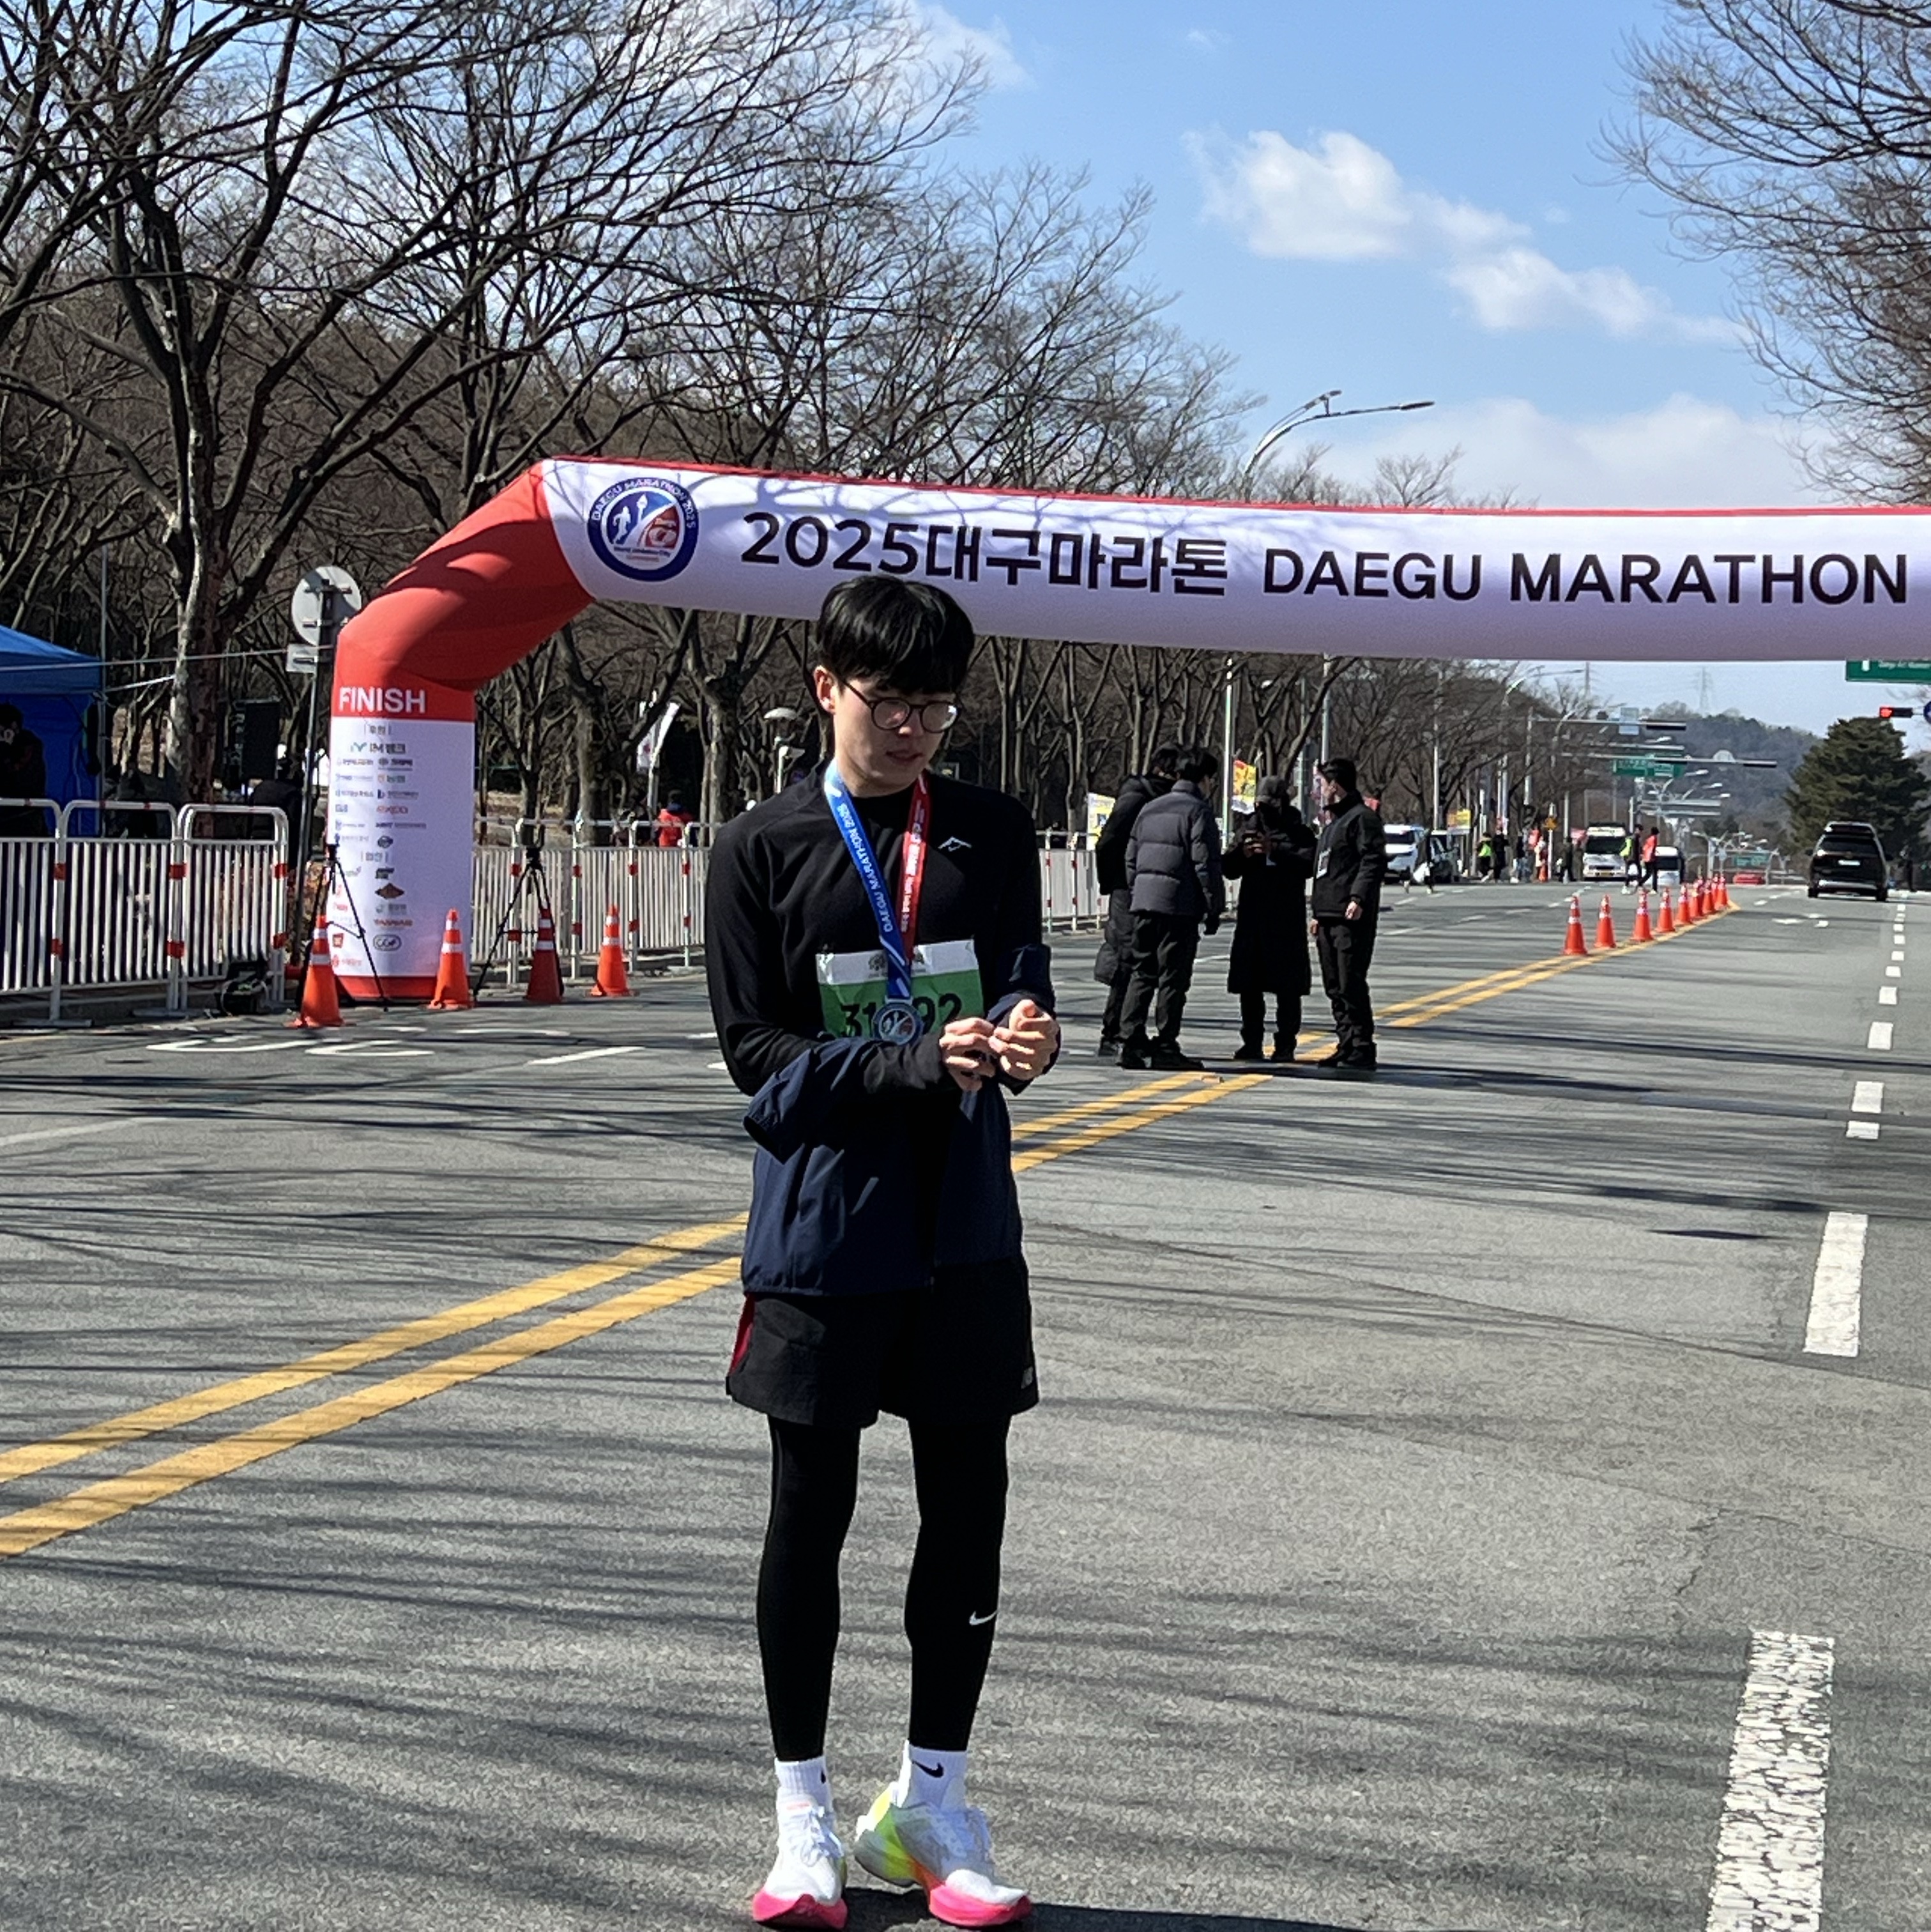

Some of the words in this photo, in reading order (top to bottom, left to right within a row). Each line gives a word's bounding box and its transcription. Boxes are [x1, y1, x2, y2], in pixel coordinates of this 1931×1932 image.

[592, 484, 622, 521] DAEGU
[624, 479, 688, 501] MARATHON
[741, 512, 1228, 596] 2025대구마라톤
[1263, 548, 1482, 601] DAEGU
[1509, 553, 1907, 605] MARATHON
[339, 686, 425, 714] FINISH
[874, 891, 893, 932] DAEGU
[841, 993, 962, 1038] 3192
